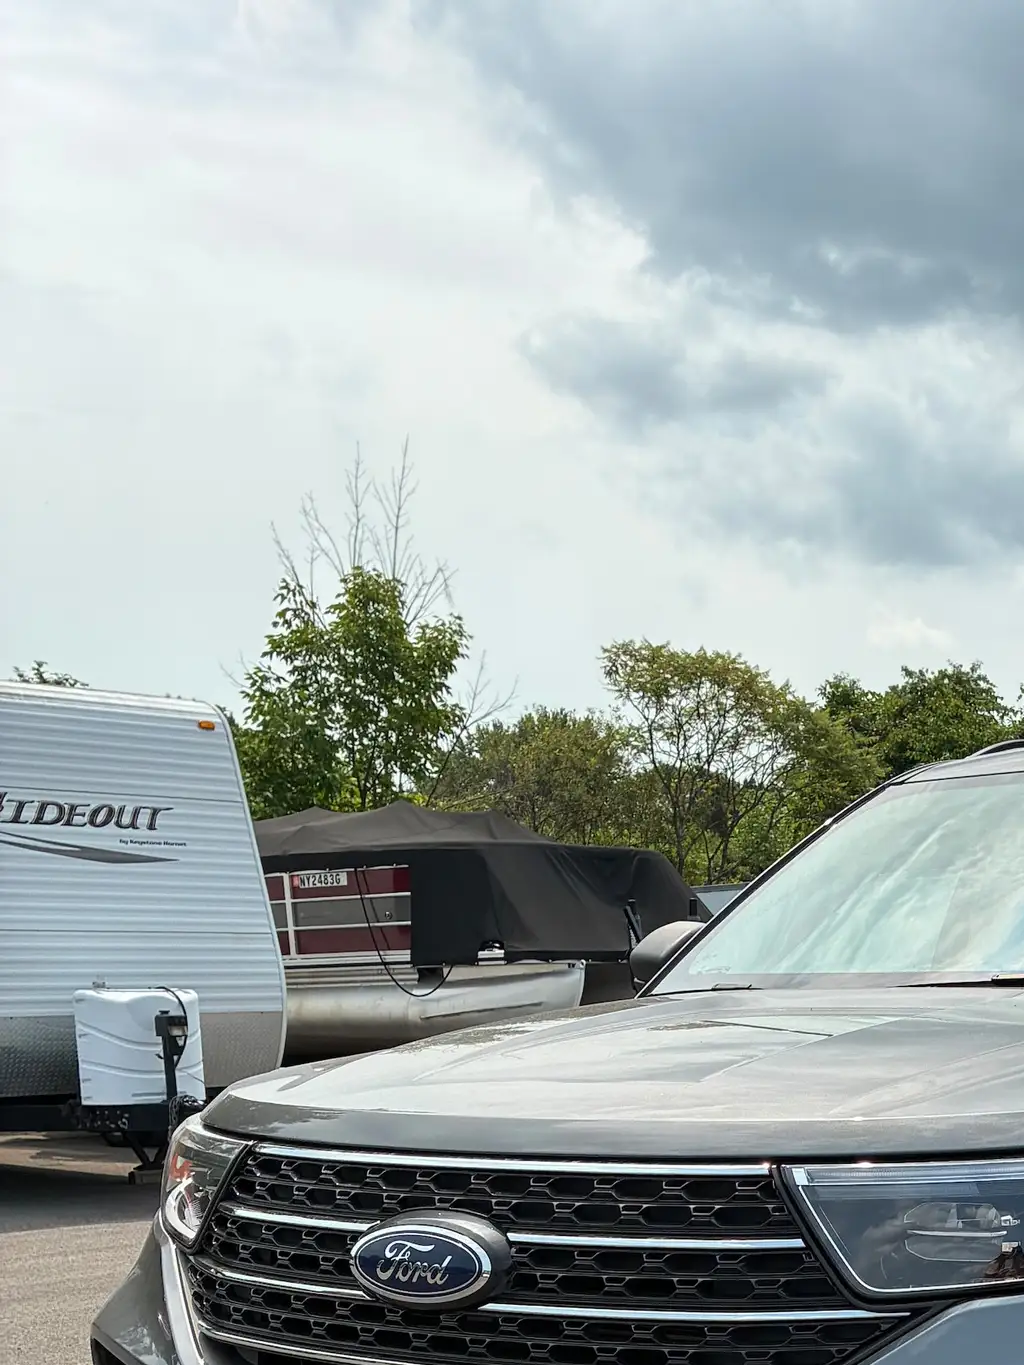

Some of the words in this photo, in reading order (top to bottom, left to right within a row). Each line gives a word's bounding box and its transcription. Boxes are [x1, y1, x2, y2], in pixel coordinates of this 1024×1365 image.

[0, 792, 174, 831] IDEOUT
[300, 873, 341, 887] NY2483G
[376, 1240, 452, 1286] Ford
